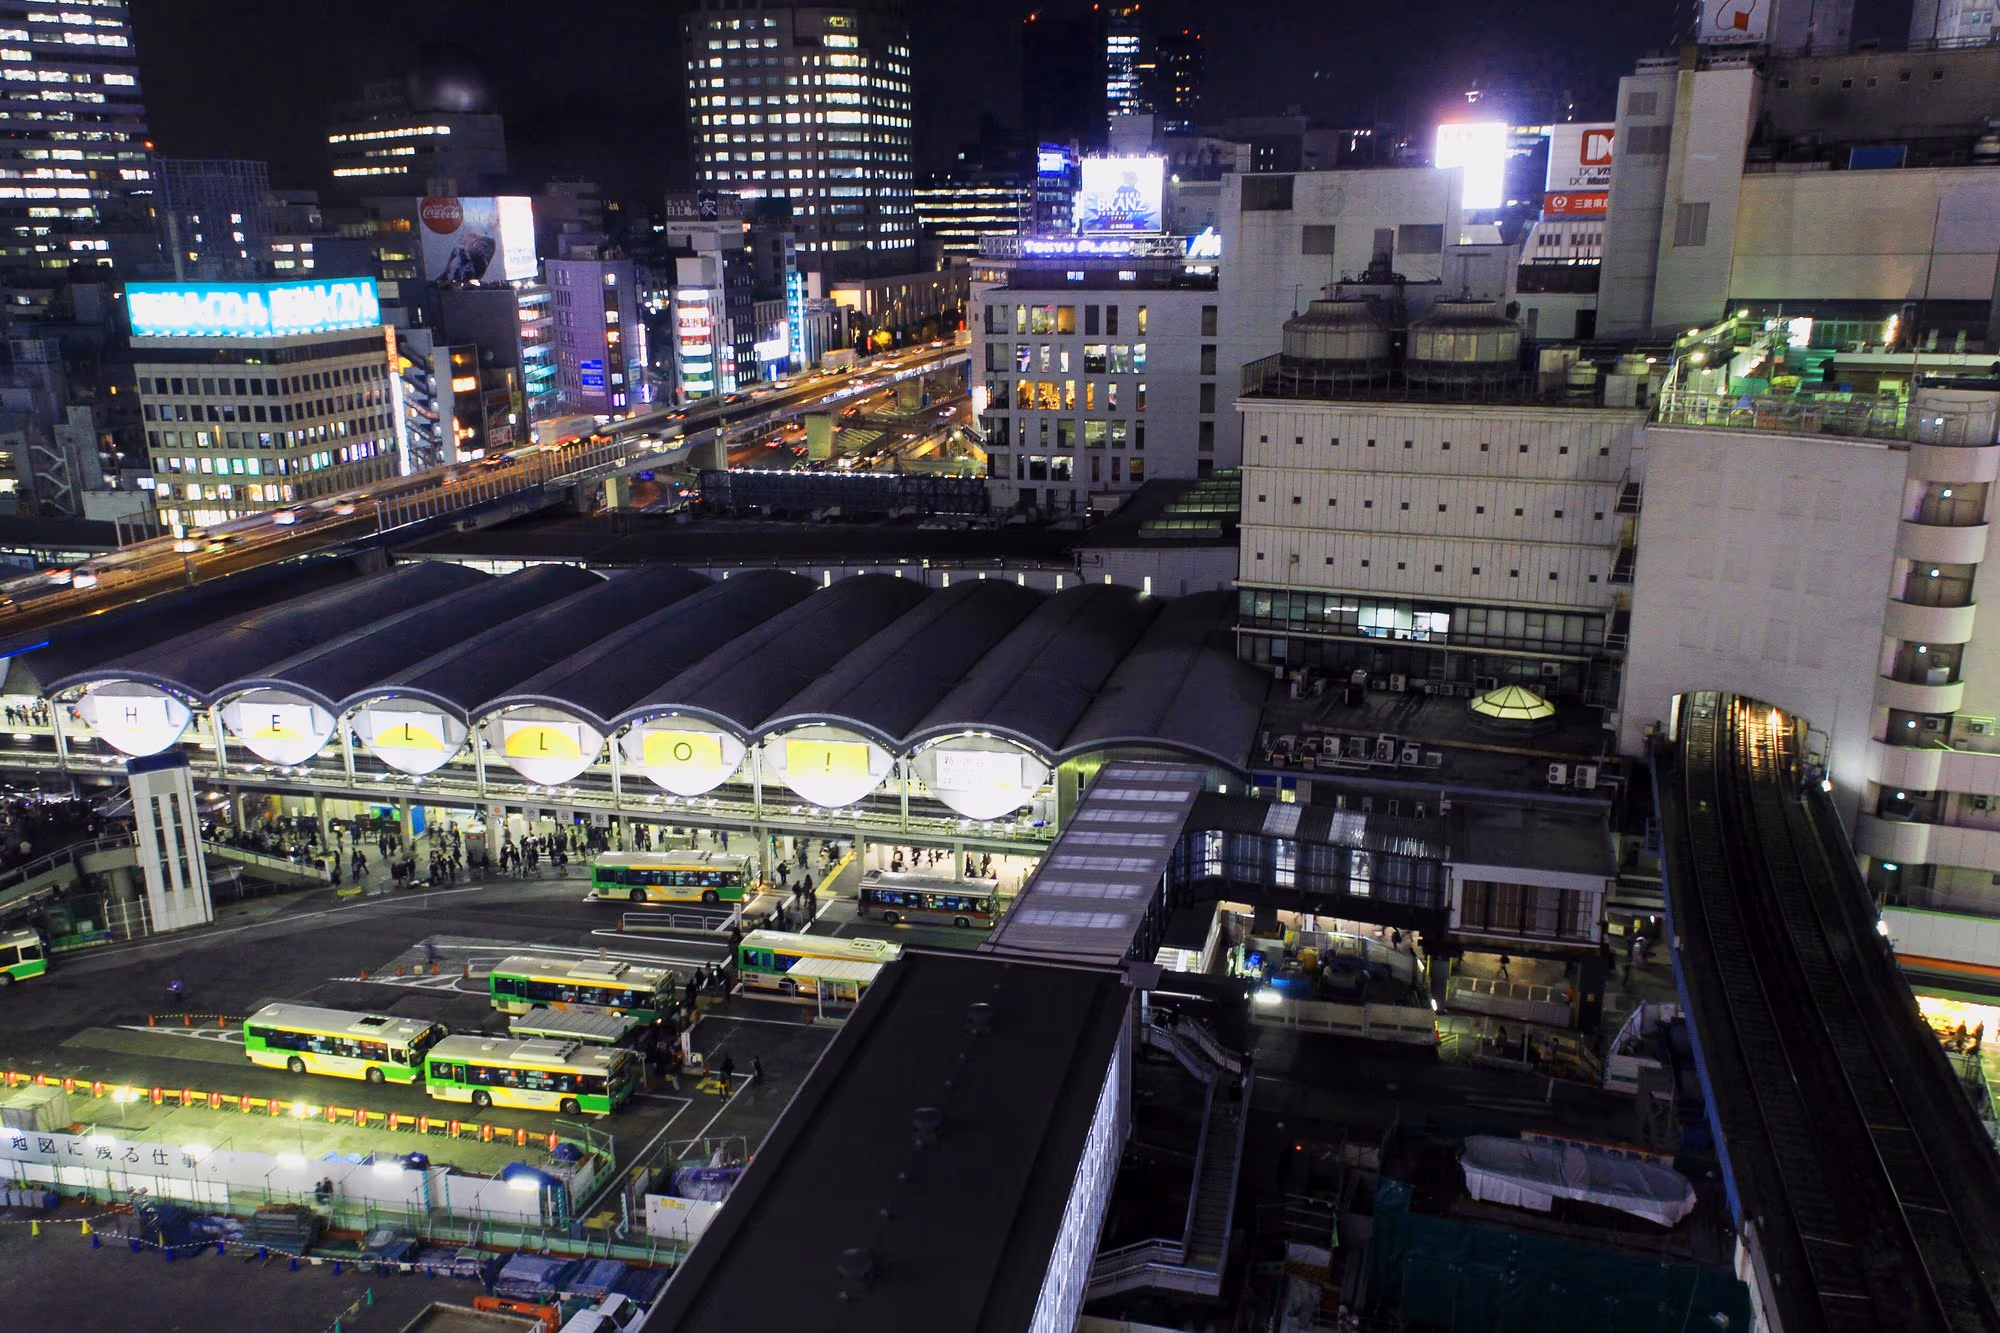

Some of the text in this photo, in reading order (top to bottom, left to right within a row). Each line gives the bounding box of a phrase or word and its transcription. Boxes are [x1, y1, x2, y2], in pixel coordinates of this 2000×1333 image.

[1704, 33, 1763, 42] TOKYU
[1097, 195, 1148, 211] BRANZ
[423, 204, 459, 219] Coca-Cola
[1023, 240, 1131, 254] TOKYU PLAZA
